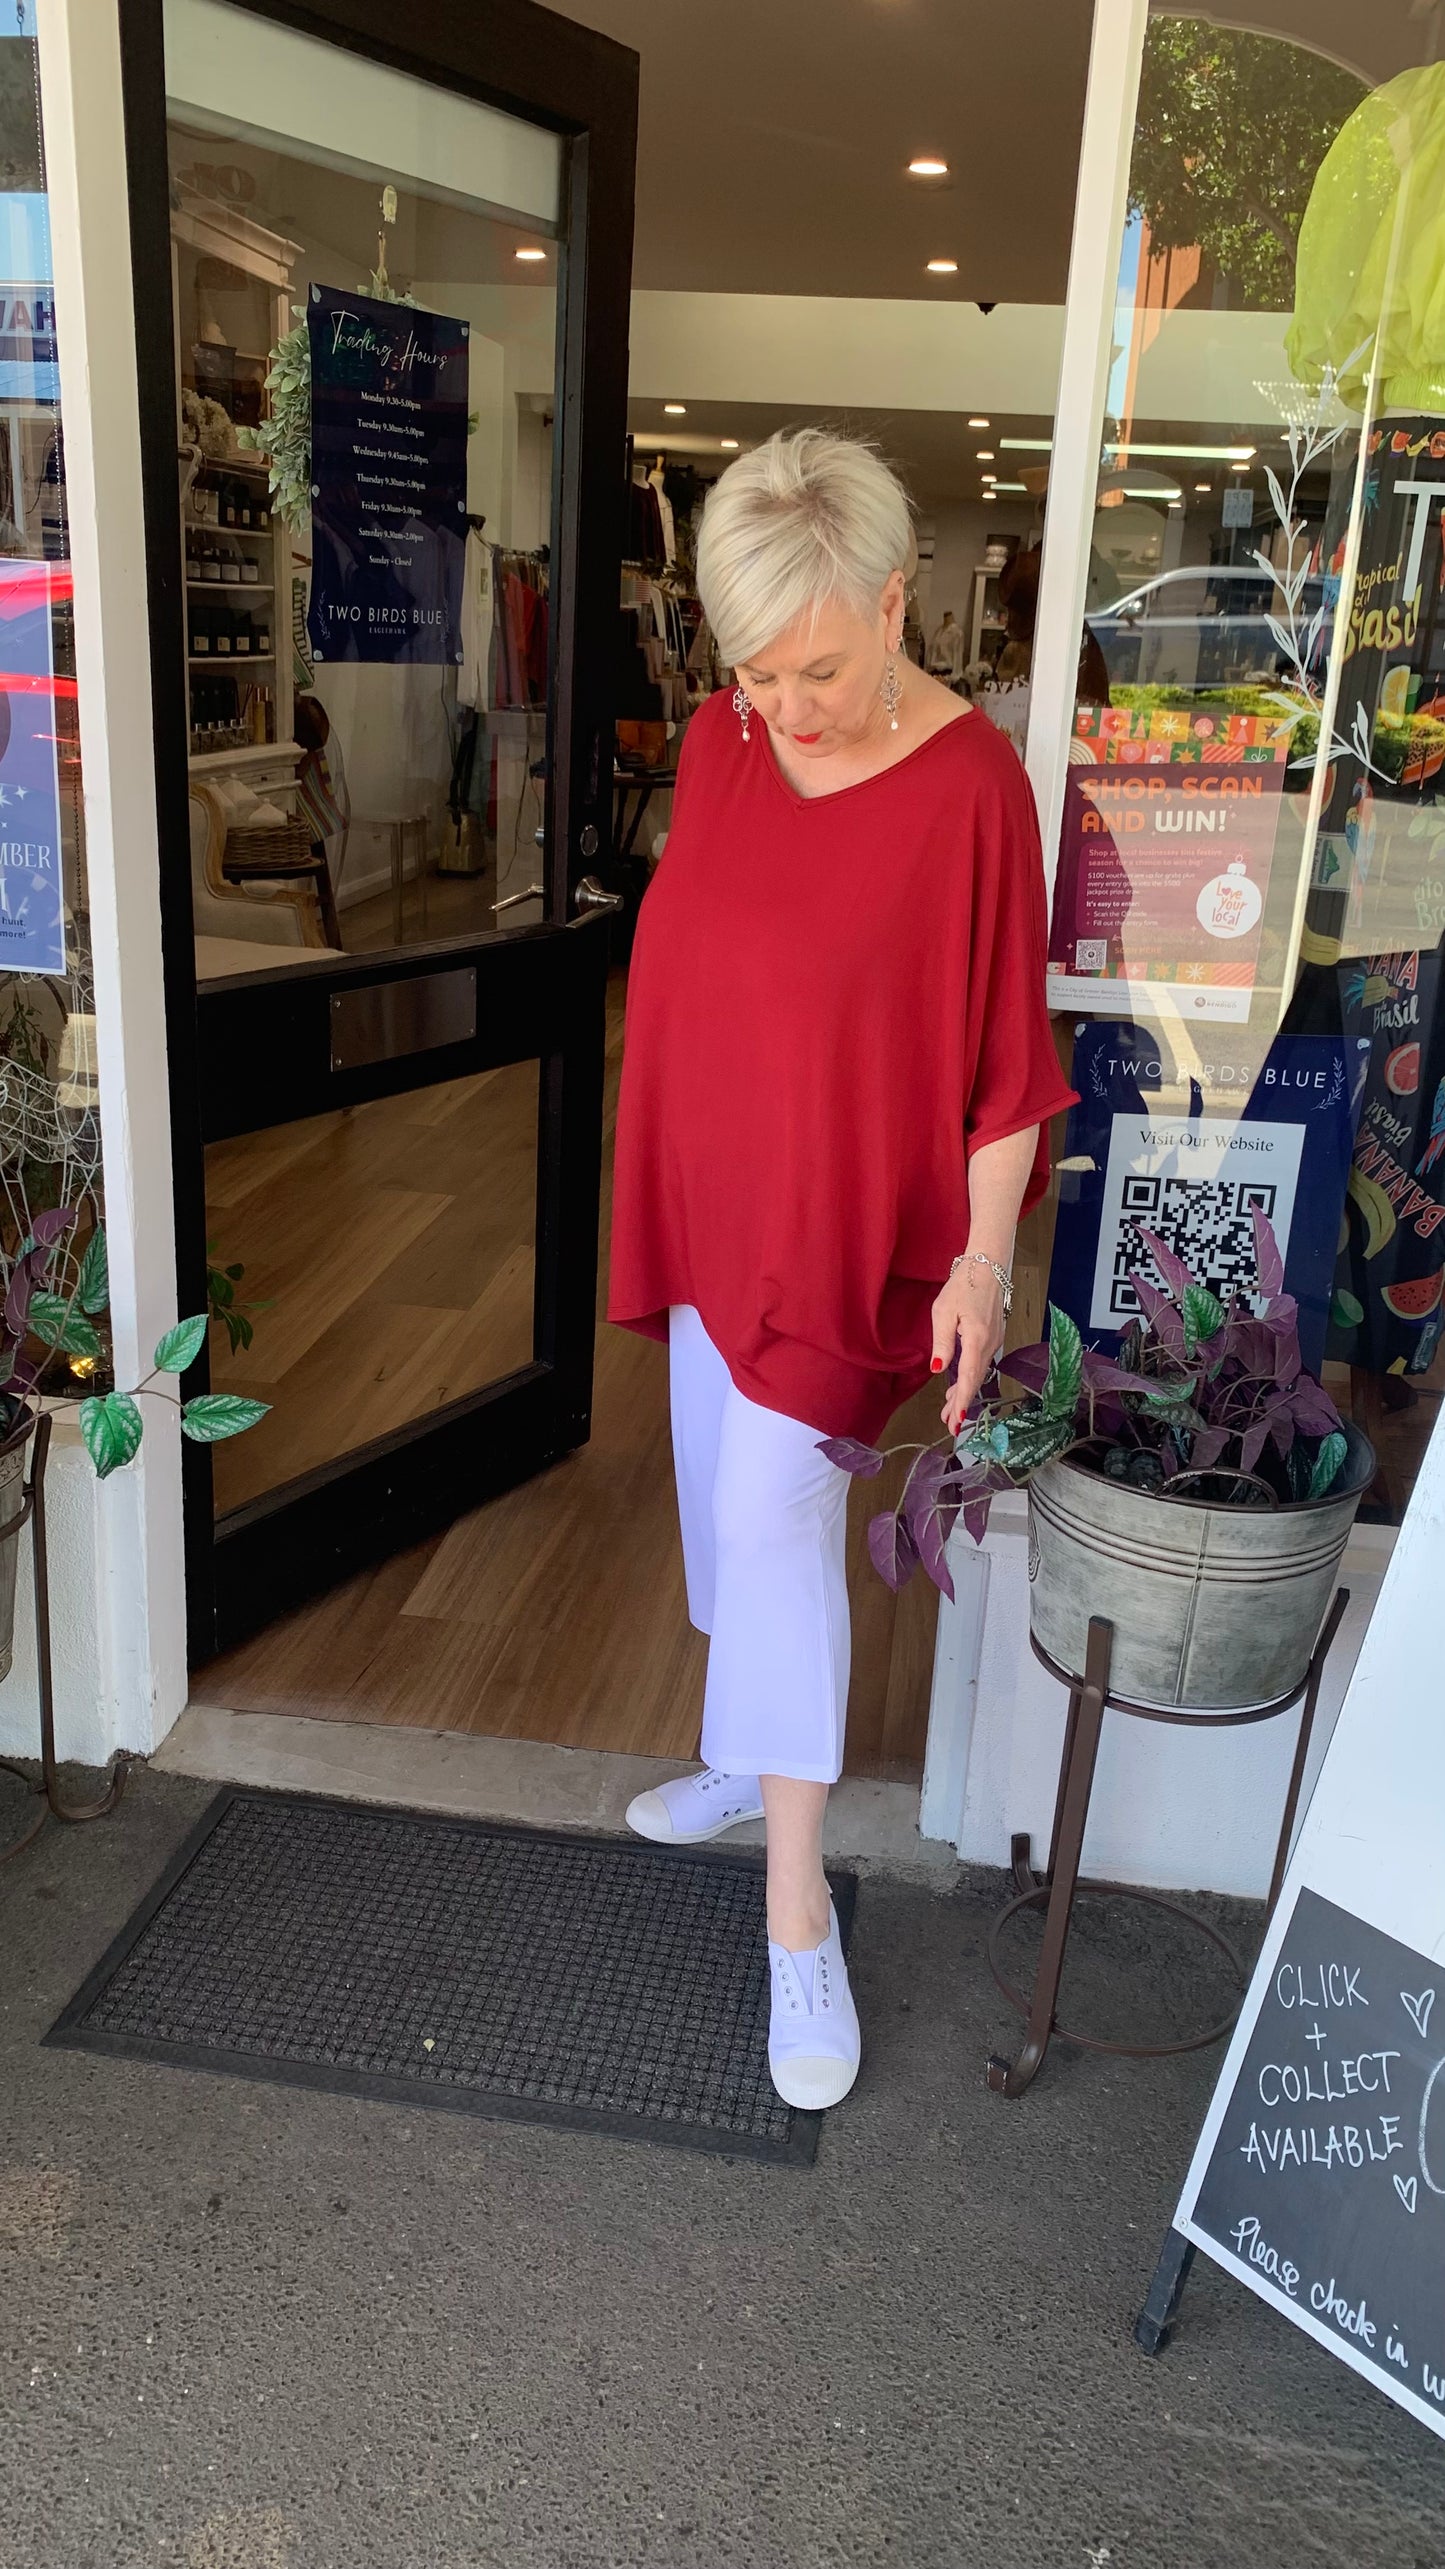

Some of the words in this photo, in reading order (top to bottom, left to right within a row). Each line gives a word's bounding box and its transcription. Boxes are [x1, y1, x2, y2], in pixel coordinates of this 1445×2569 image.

[331, 310, 393, 367] Trading
[400, 330, 448, 371] Hours
[361, 391, 385, 406] Monday
[357, 418, 381, 432] Tuesday
[352, 445, 387, 460] Wednesday
[357, 473, 383, 487] Thursday
[361, 501, 380, 513] Friday
[358, 528, 383, 540] Saturday
[369, 555, 389, 567] Sunday
[395, 557, 412, 566] Closed
[1355, 551, 1403, 602] ropical
[328, 605, 361, 621] TWO
[368, 607, 407, 623] BIRDS
[413, 609, 442, 625] BLUE
[1082, 777, 1172, 804] SHOP,
[1182, 777, 1263, 799] SCAN
[1081, 811, 1145, 832] AND
[1155, 810, 1227, 832] WIN!
[1089, 849, 1108, 858] Shop
[1139, 849, 1178, 857] businesses
[1197, 849, 1222, 857] festive
[1217, 897, 1248, 912] your
[1212, 907, 1240, 926] local
[1108, 1059, 1162, 1077] TWO
[1177, 1063, 1250, 1082] BIRDS
[1264, 1068, 1327, 1089] BLUE
[1140, 1131, 1174, 1145] Visit
[1180, 1133, 1210, 1147] Our
[1214, 1135, 1274, 1152] Website
[1277, 1963, 1370, 2009] CLICK
[1305, 2022, 1327, 2050] +
[1259, 2051, 1401, 2106] COLLECT
[1240, 2116, 1404, 2174] AVAILABLE
[1229, 2216, 1300, 2296] Please
[1310, 2278, 1377, 2347] check
[1386, 2324, 1409, 2368] in
